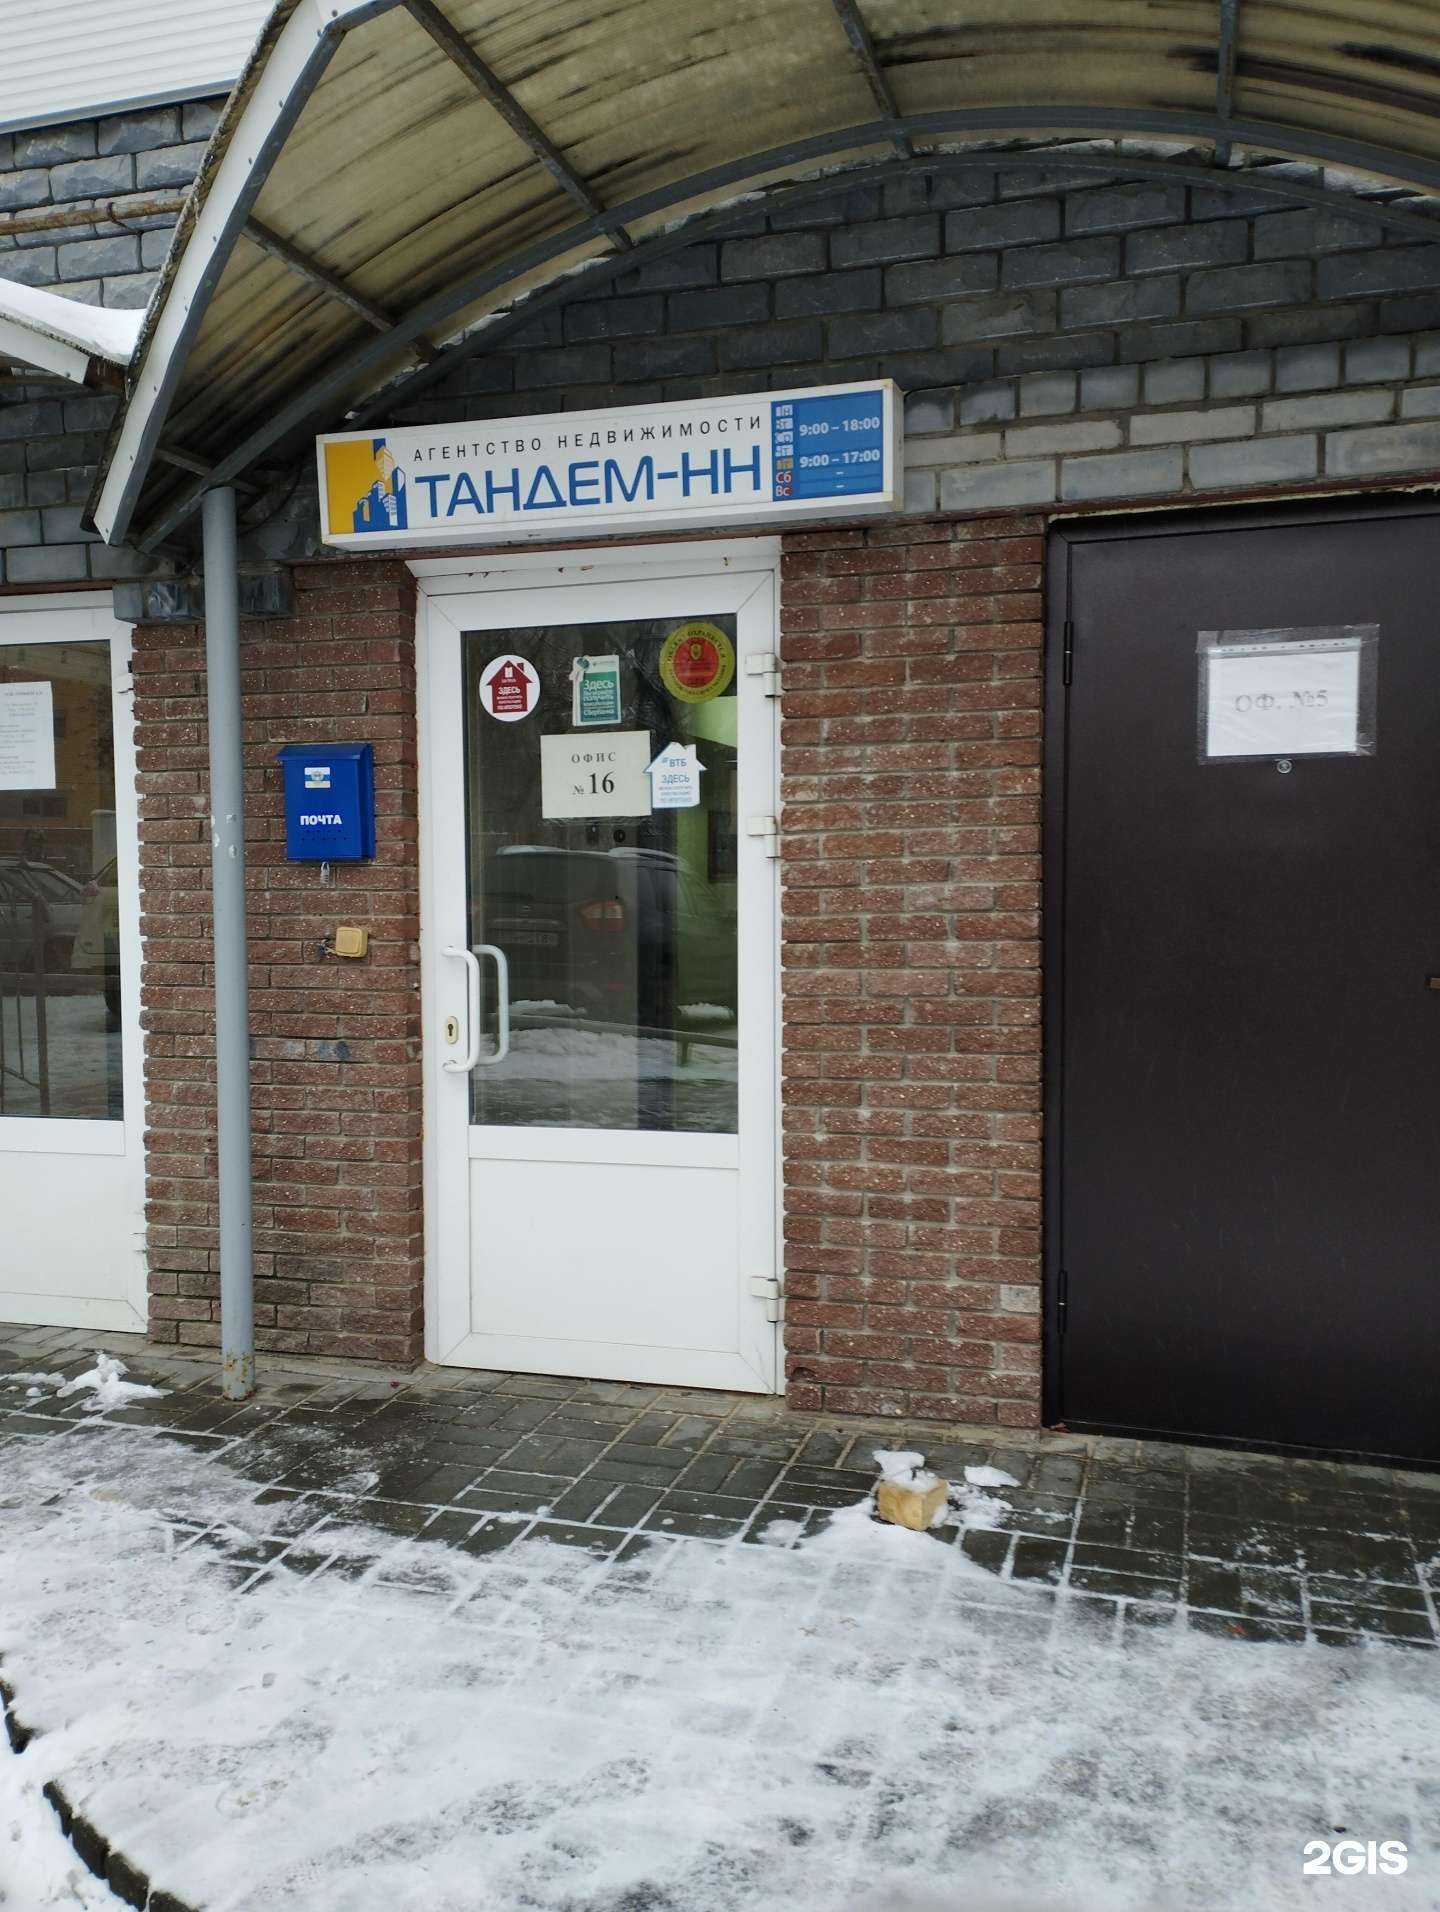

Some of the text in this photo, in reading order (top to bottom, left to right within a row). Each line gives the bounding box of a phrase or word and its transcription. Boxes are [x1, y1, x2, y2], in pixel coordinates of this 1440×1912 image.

[800, 422, 829, 437] 9:00
[842, 416, 881, 432] 18:00
[413, 437, 541, 462] АГЕНТСТВО
[558, 415, 760, 449] НЕДВИЖИМОСТИ
[800, 454, 830, 469] 9:00
[842, 449, 881, 464] 17:00
[415, 445, 760, 518] ТАНДЕМ-НН
[775, 470, 793, 485] Сб
[775, 485, 793, 497] Вс
[571, 751, 616, 764] ОФИС
[669, 758, 688, 768] ВТБ
[589, 771, 615, 794] 16
[661, 773, 690, 784] ЗДЕСЬ
[300, 814, 343, 826] ПОЧТА
